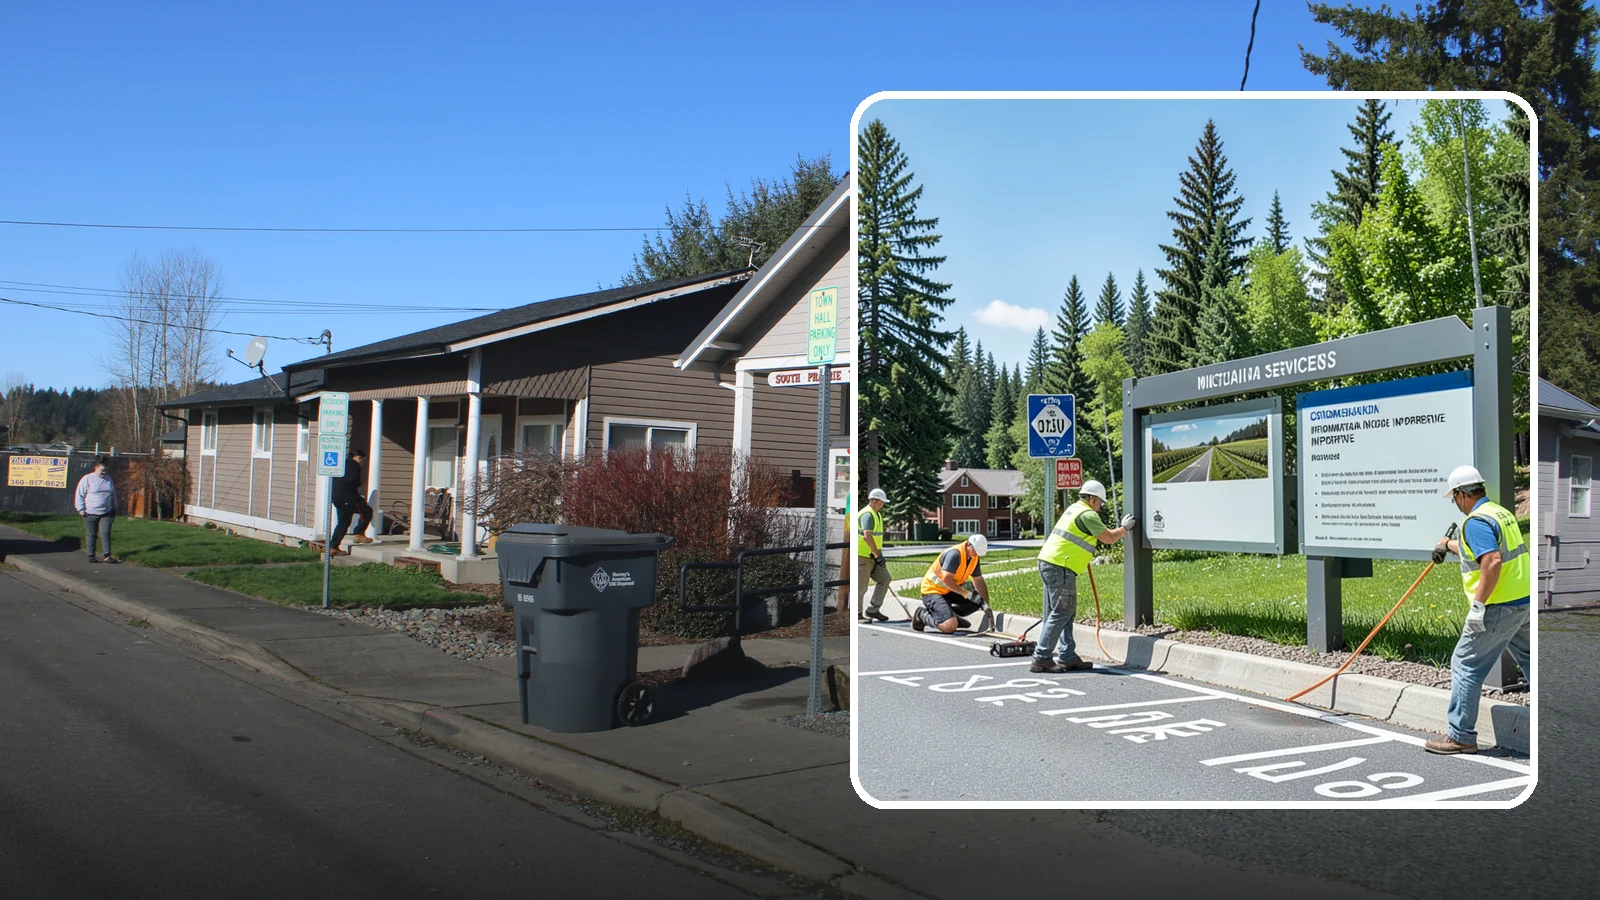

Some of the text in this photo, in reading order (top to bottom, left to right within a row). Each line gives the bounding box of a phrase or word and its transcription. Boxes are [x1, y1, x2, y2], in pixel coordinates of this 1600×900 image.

[815, 295, 833, 307] TOWN
[815, 312, 831, 324] HALL
[810, 326, 836, 340] PARKING
[813, 344, 831, 357] ONLY
[775, 373, 802, 384] SOUTH
